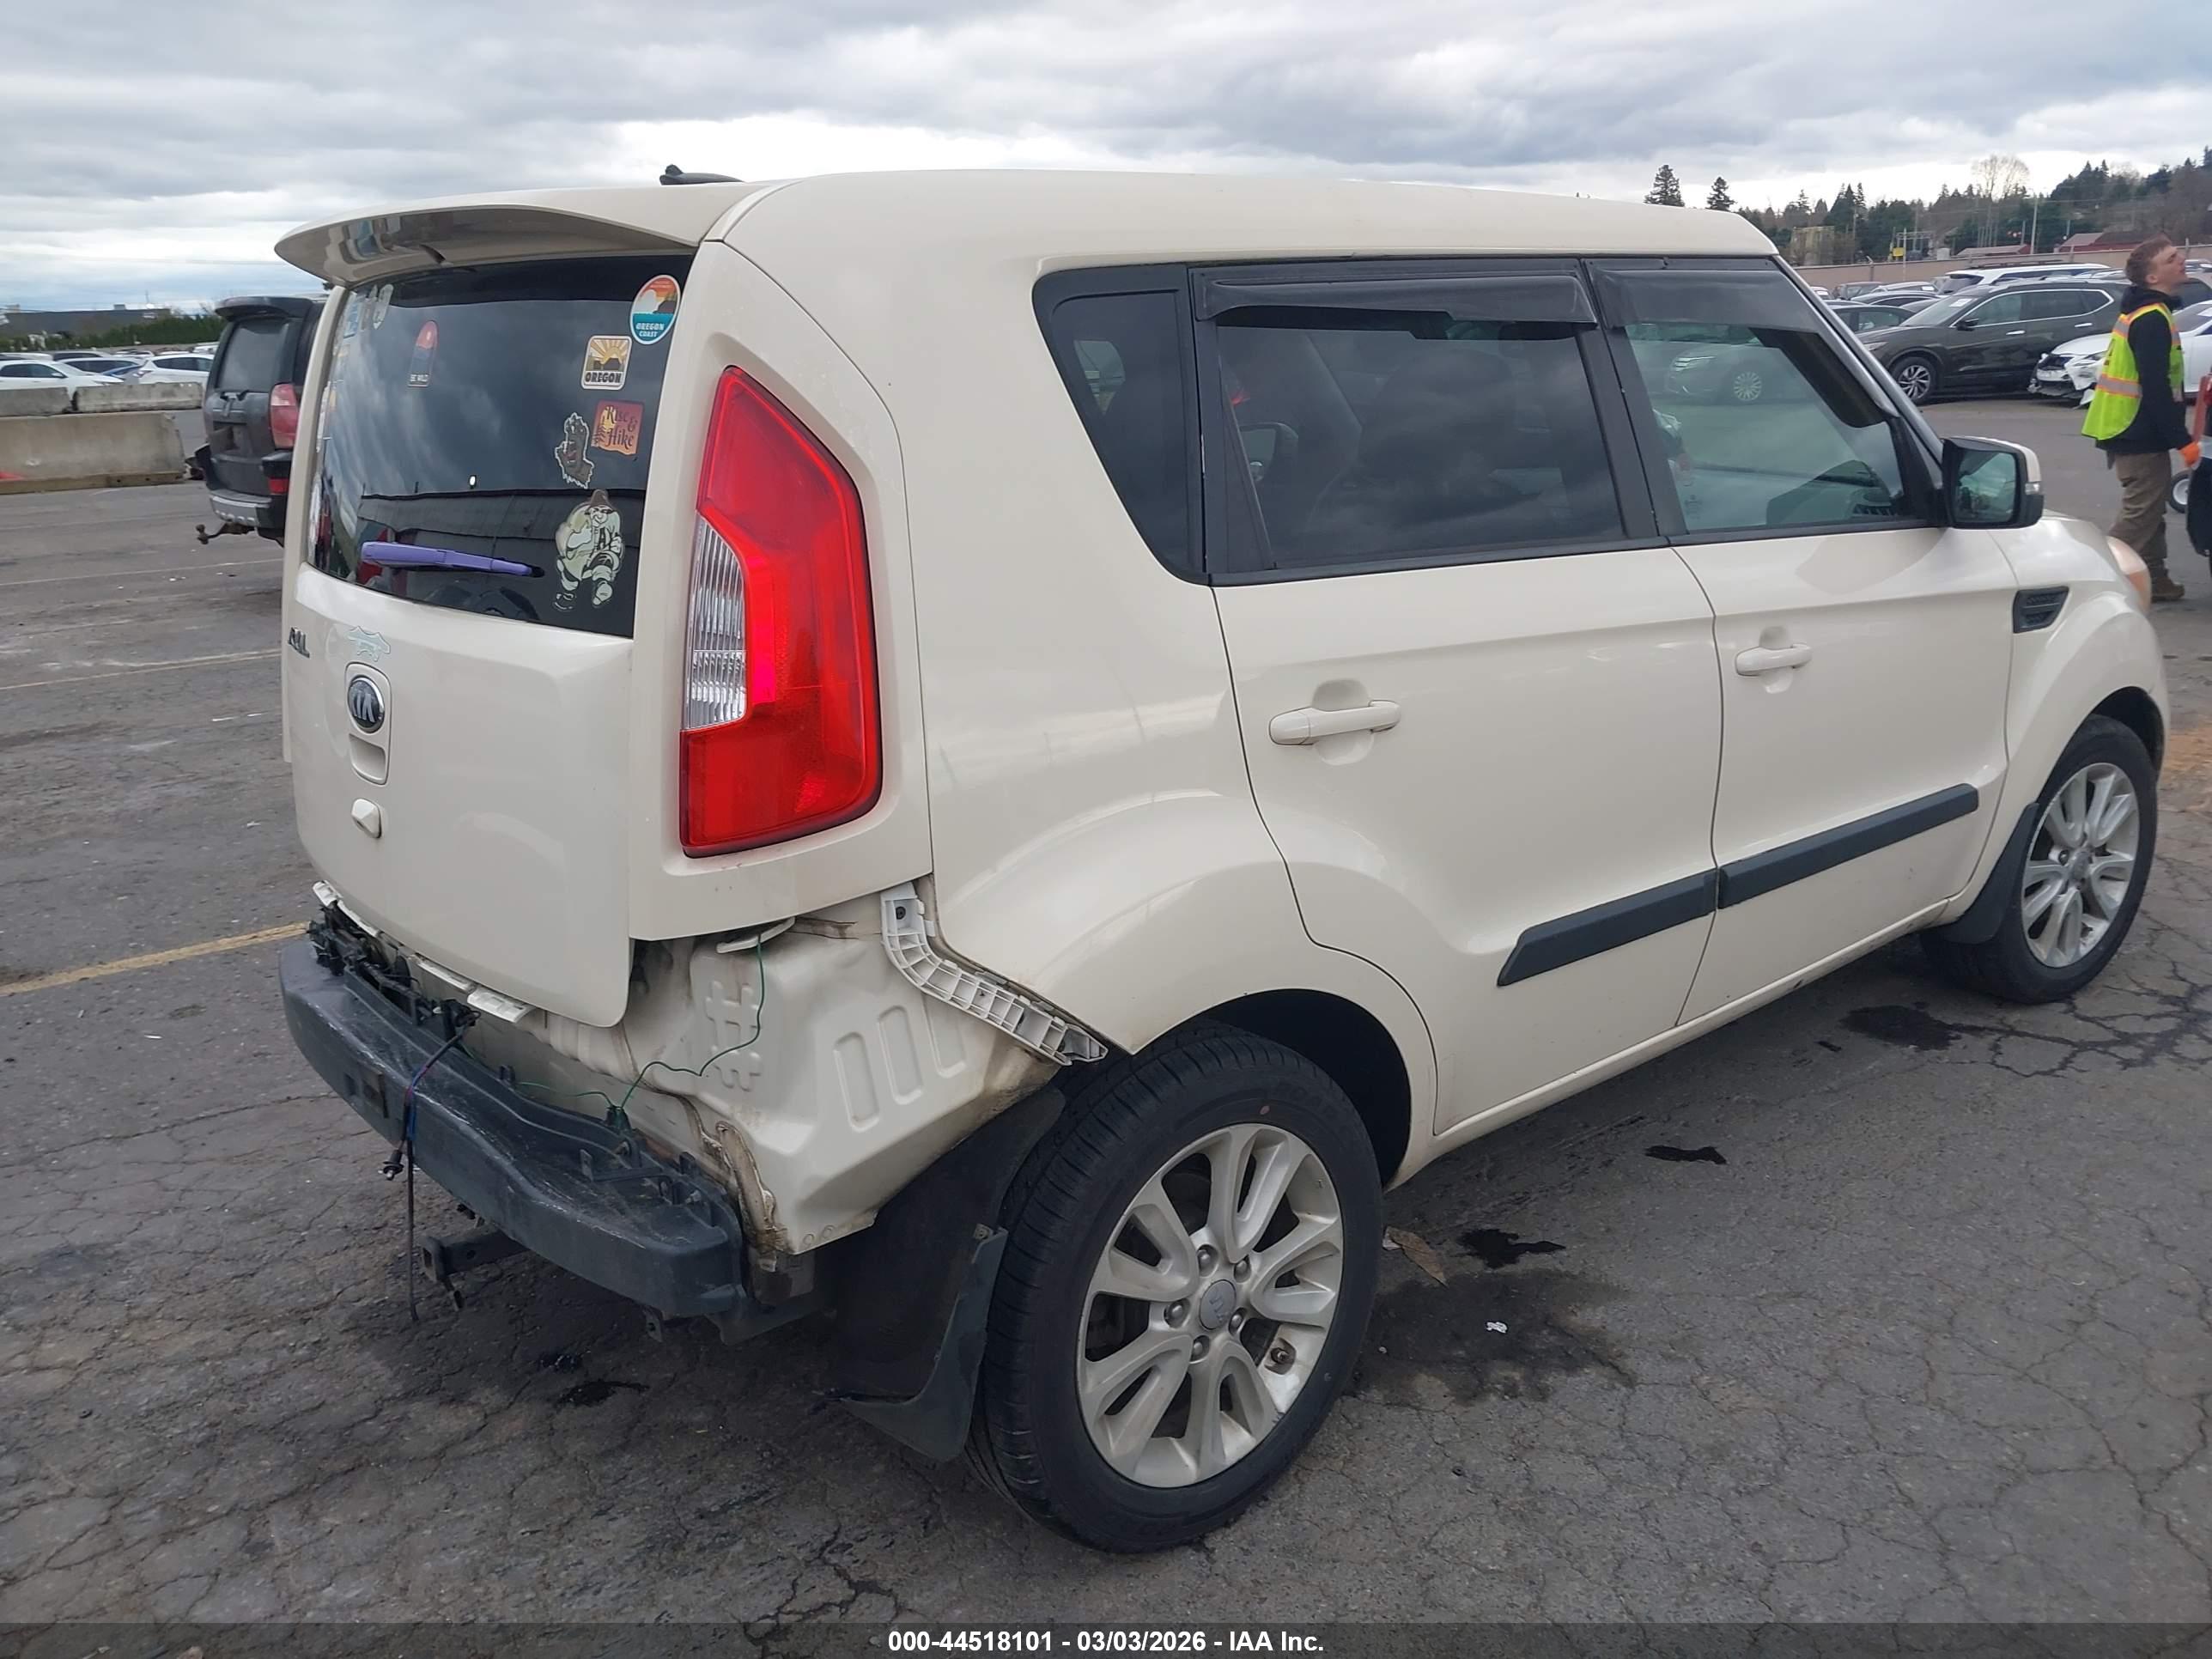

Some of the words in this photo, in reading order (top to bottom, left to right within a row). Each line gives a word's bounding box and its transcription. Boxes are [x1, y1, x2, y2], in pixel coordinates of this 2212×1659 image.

[635, 322, 665, 331] OREGON
[585, 372, 623, 383] OREGON
[605, 405, 629, 424] Rise
[628, 416, 637, 432] &
[605, 428, 635, 449] Hike
